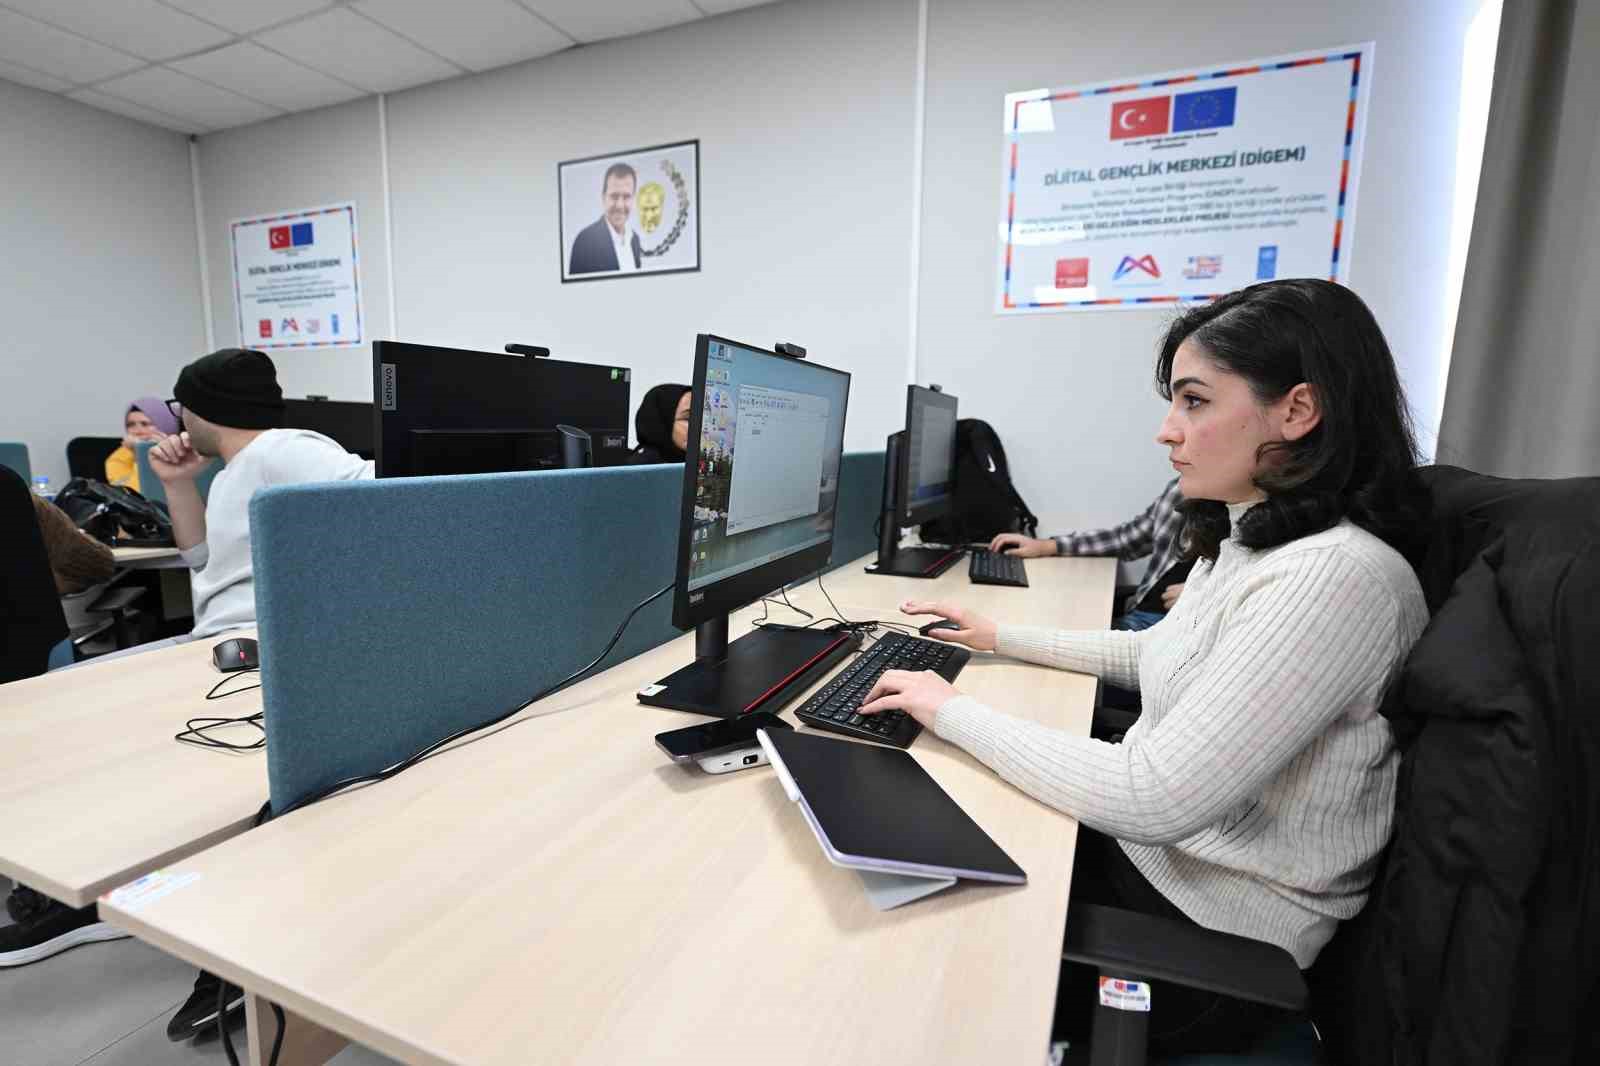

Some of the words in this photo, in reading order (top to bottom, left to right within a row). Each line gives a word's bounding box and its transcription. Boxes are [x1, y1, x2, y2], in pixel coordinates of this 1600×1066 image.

[1098, 157, 1163, 181] GENÇLİK
[1166, 150, 1236, 174] MERKEZİ
[1240, 146, 1306, 168] (DİGEM)
[384, 367, 393, 406] Lenovo
